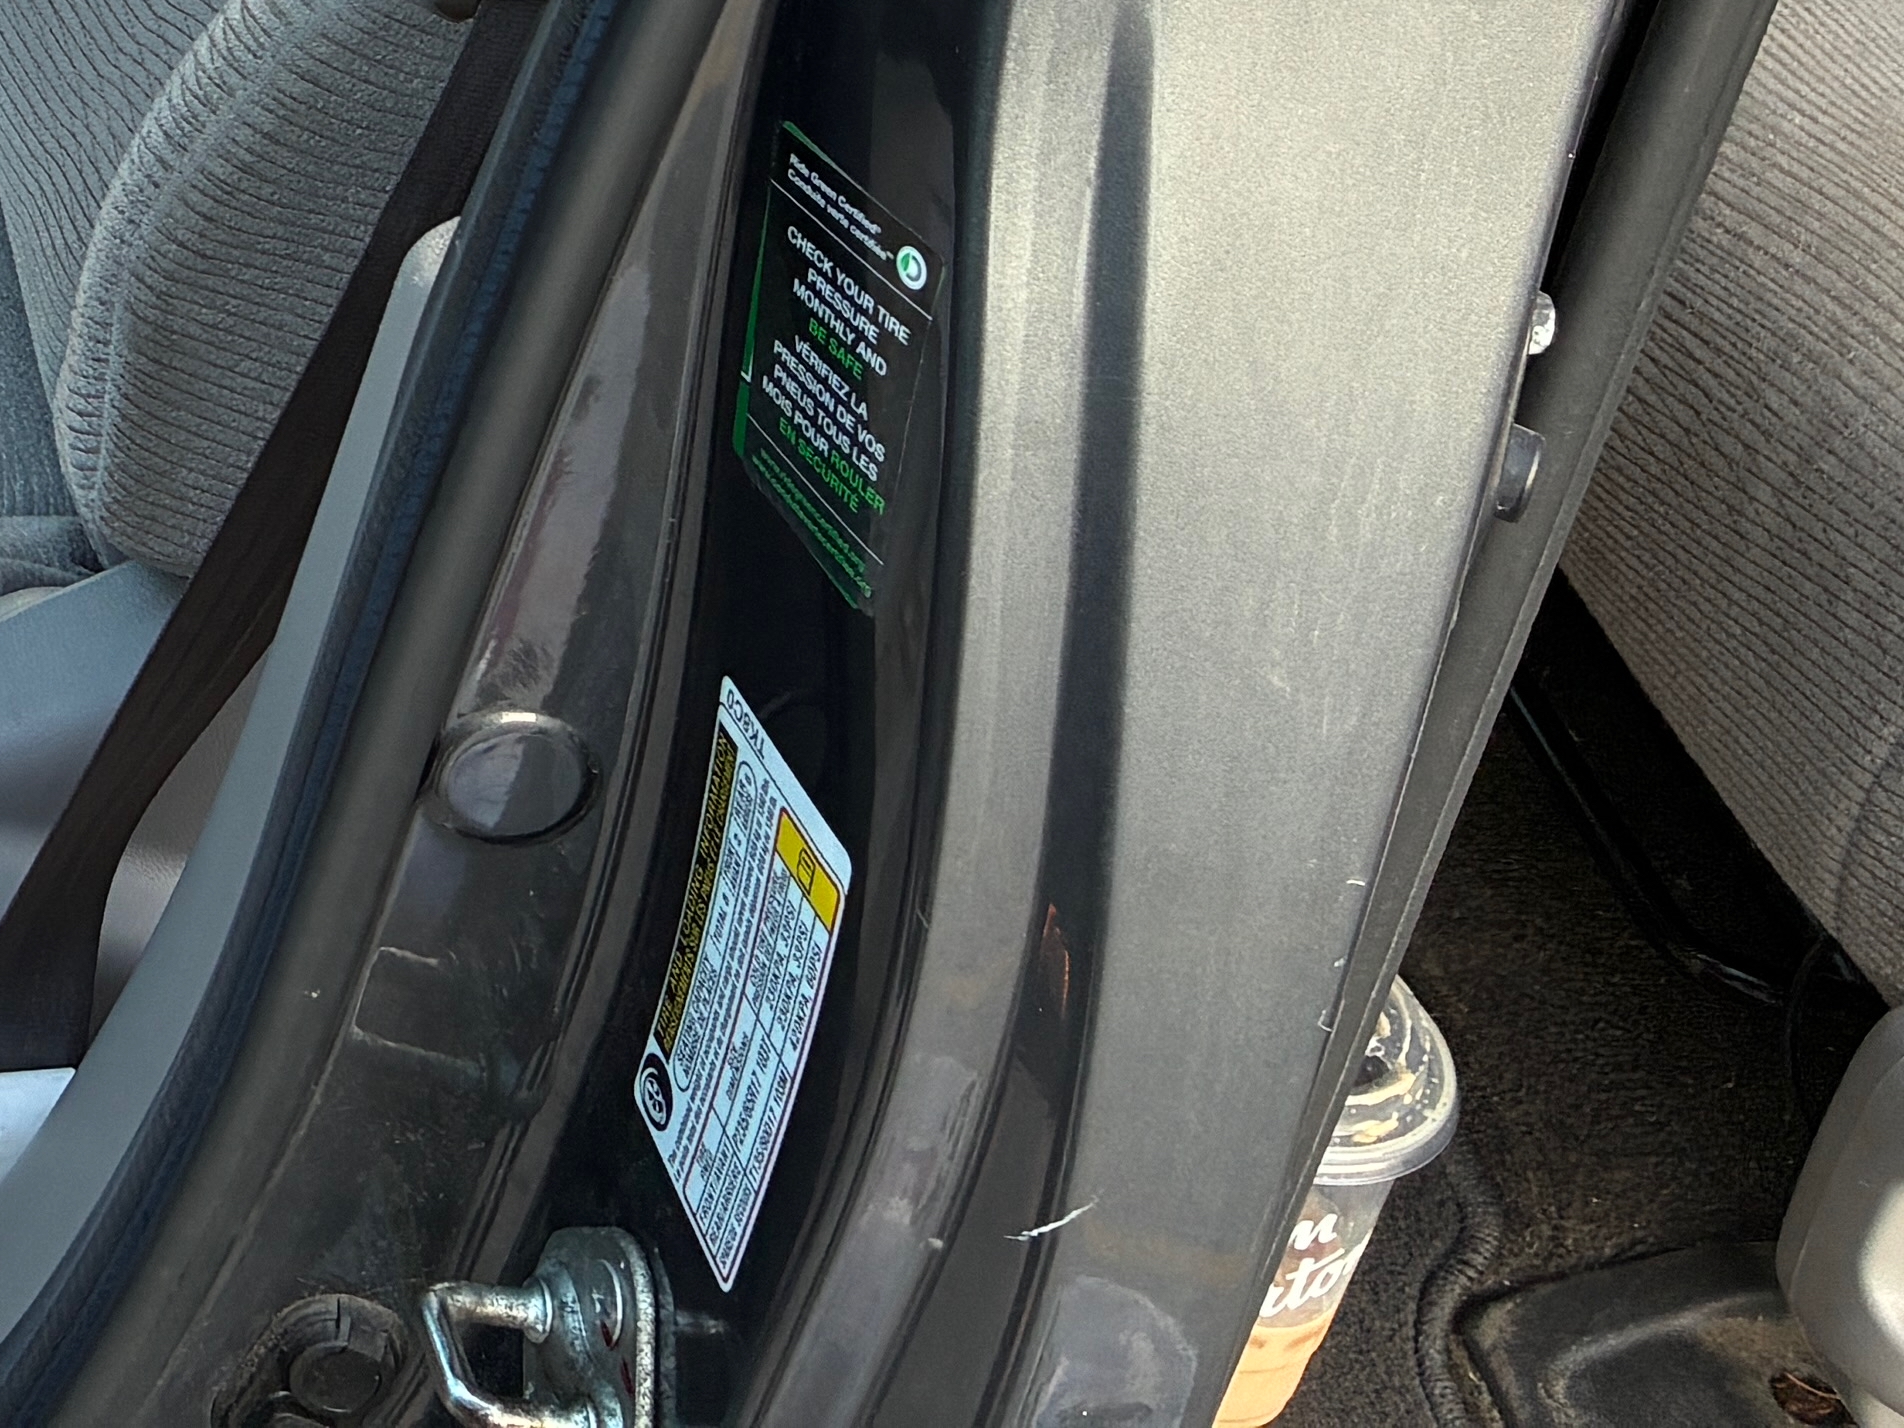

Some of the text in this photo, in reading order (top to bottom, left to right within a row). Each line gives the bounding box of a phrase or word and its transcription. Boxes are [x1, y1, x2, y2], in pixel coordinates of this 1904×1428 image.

[786, 222, 911, 349] CHECK YOUR TIRE
[792, 275, 888, 380] MONTHLY AND
[806, 263, 879, 347] PRESSURE
[772, 336, 886, 466] PRESSION DE VOS
[792, 329, 870, 423] VÉRIFIEZ LA
[808, 315, 864, 383] BE SAFE
[760, 372, 886, 519] MOIS POUR ROULER
[773, 361, 879, 485] PNEUS TOUS LES
[778, 415, 796, 447] EN
[657, 731, 728, 1038] TIRE AND LOADING INFORMATION
